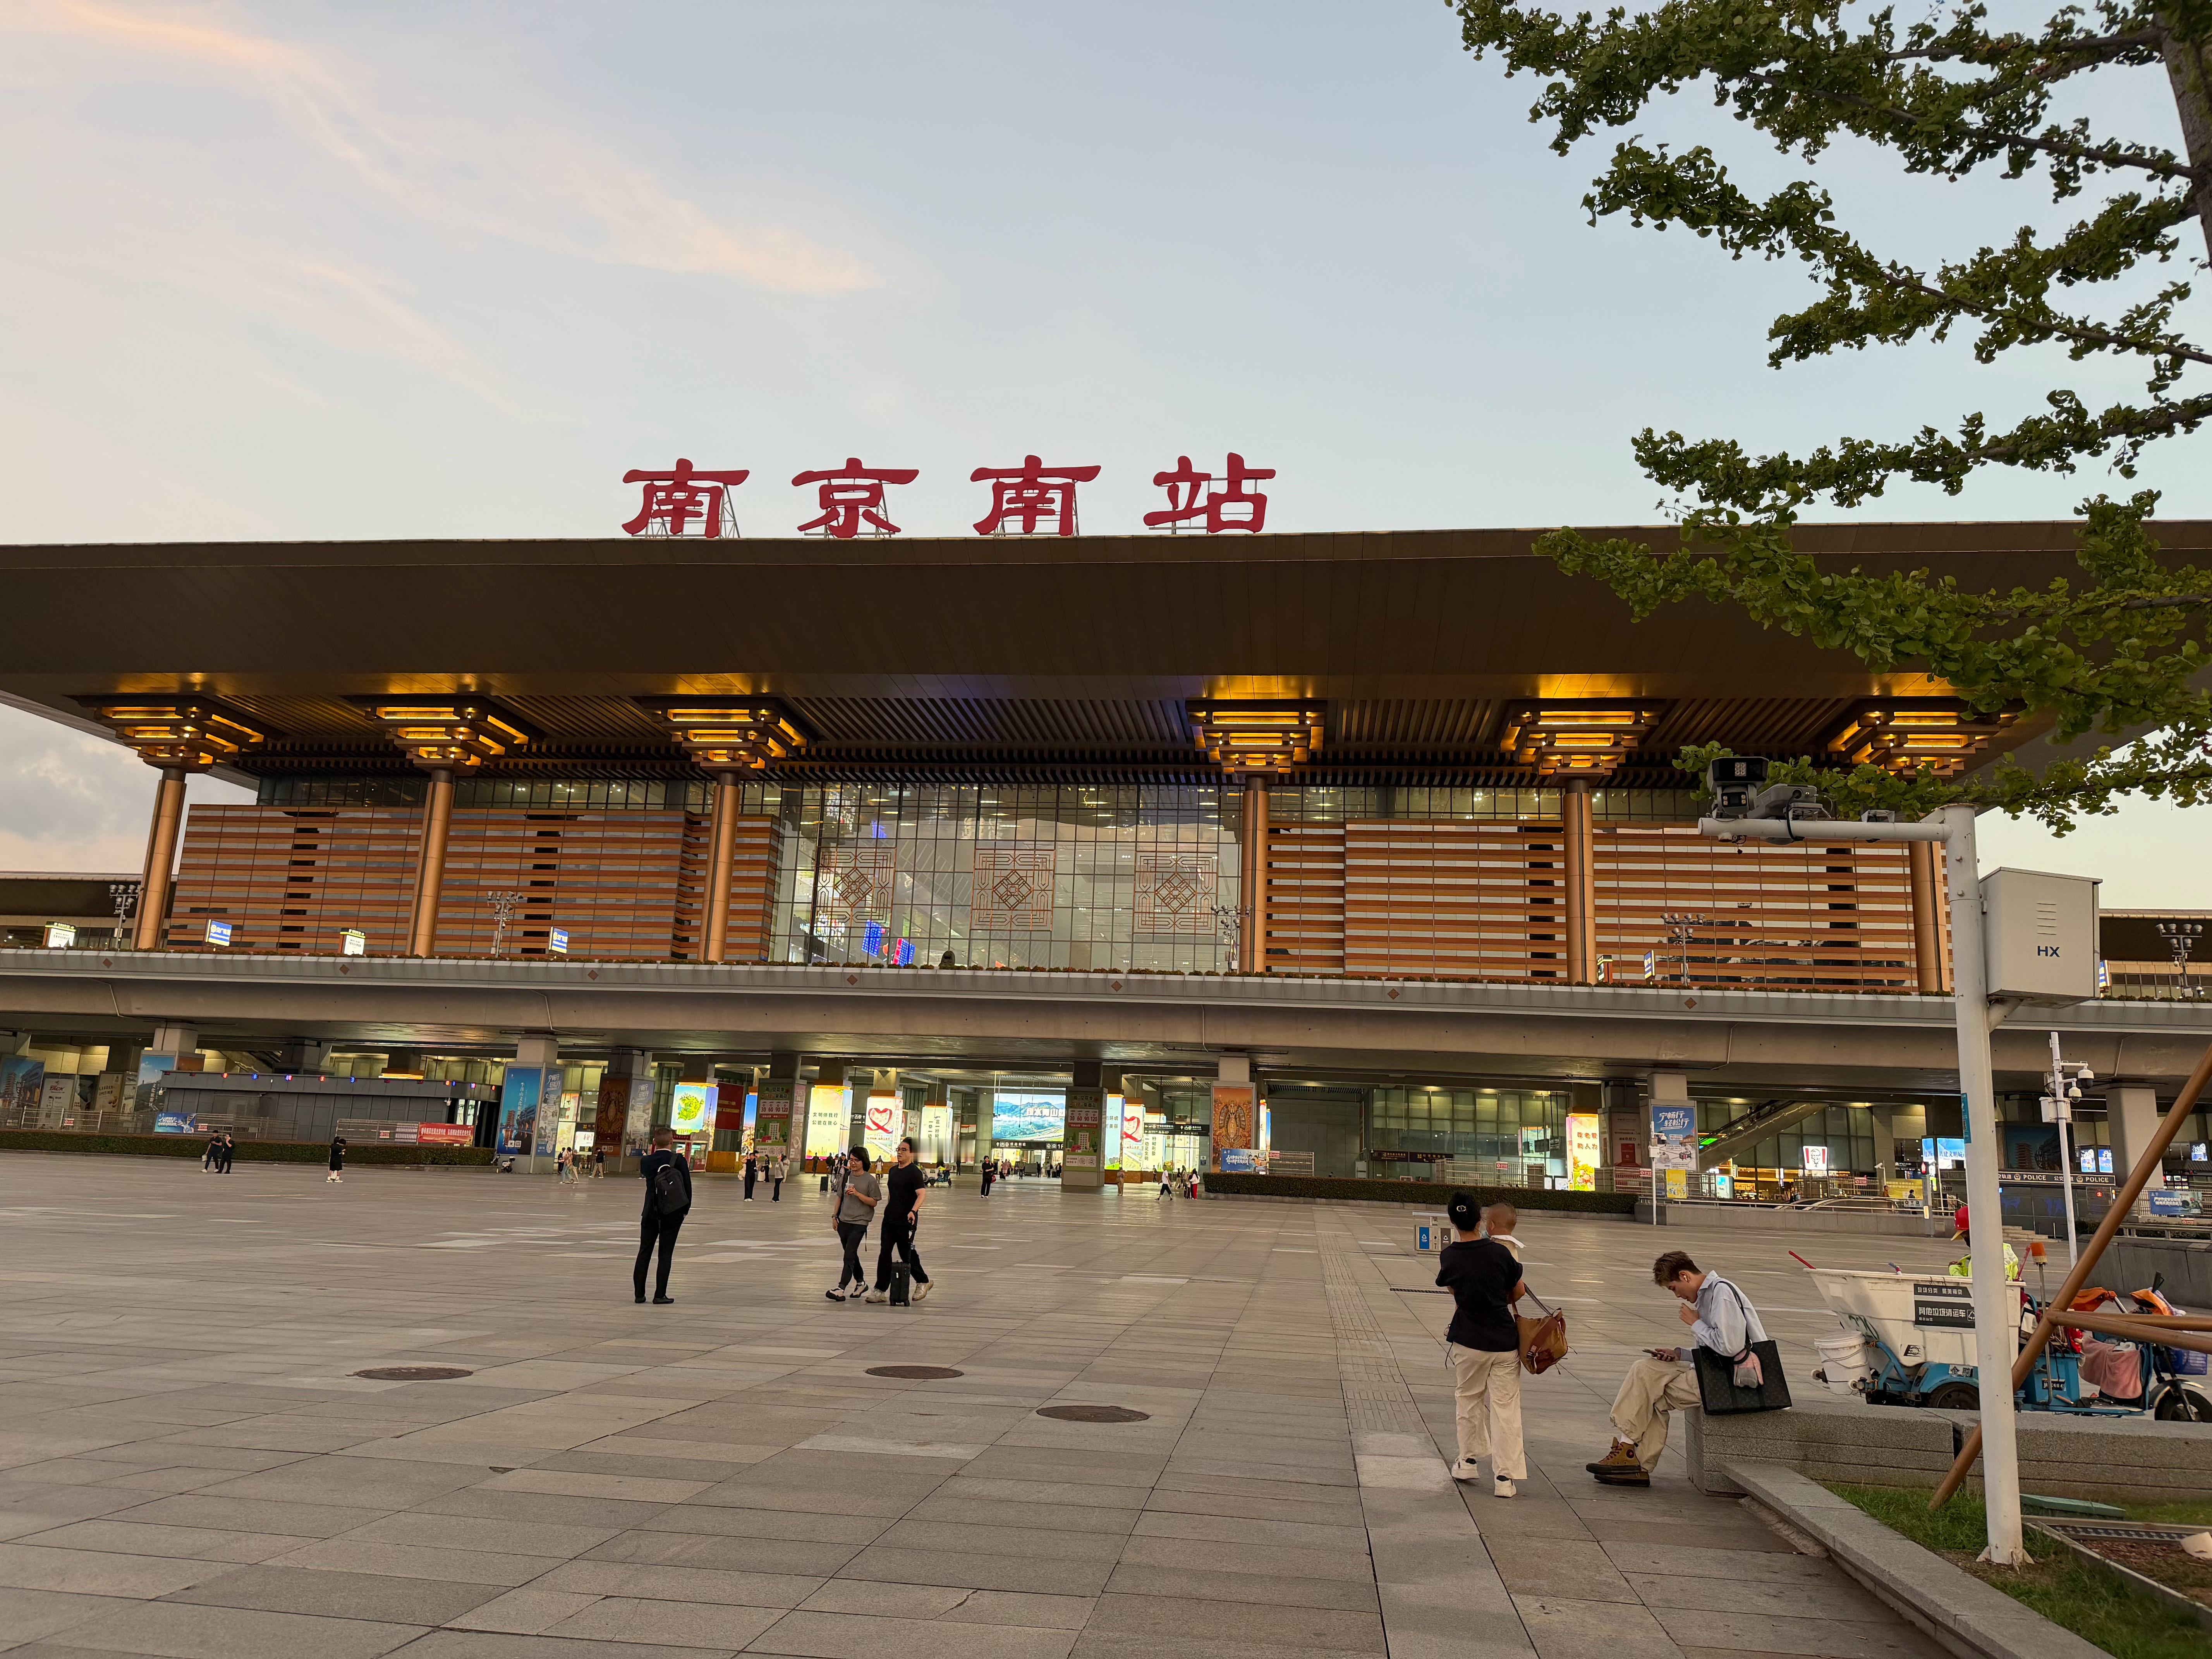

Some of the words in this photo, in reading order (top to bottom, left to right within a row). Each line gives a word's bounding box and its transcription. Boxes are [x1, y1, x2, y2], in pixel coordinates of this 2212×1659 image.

[622, 452, 1276, 538] 南京南站
[2037, 946, 2060, 957] HX
[1657, 1111, 1685, 1123] 宁畅行
[1664, 1118, 1690, 1130] 轻松行
[1919, 1307, 1966, 1317] 其他垃圾清运车
